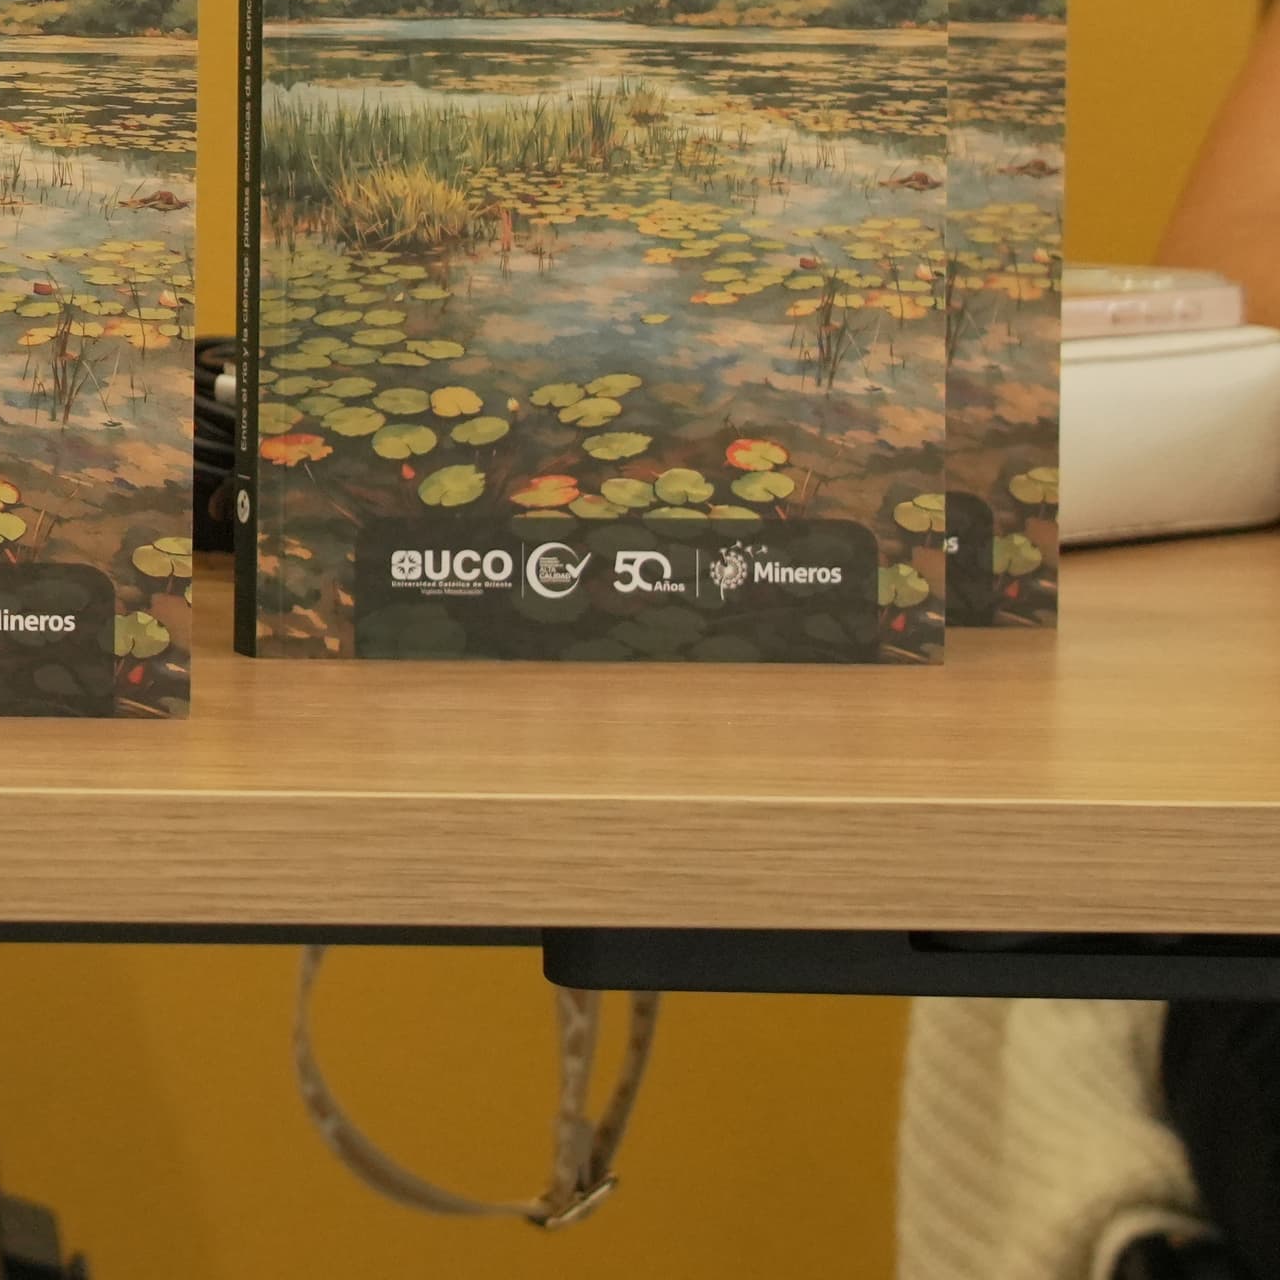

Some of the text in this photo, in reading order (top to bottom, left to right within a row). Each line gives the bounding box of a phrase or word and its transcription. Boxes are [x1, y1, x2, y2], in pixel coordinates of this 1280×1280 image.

[424, 549, 513, 582] UCO
[612, 550, 671, 592] 50
[753, 561, 842, 584] Mineros
[652, 579, 685, 593] Años
